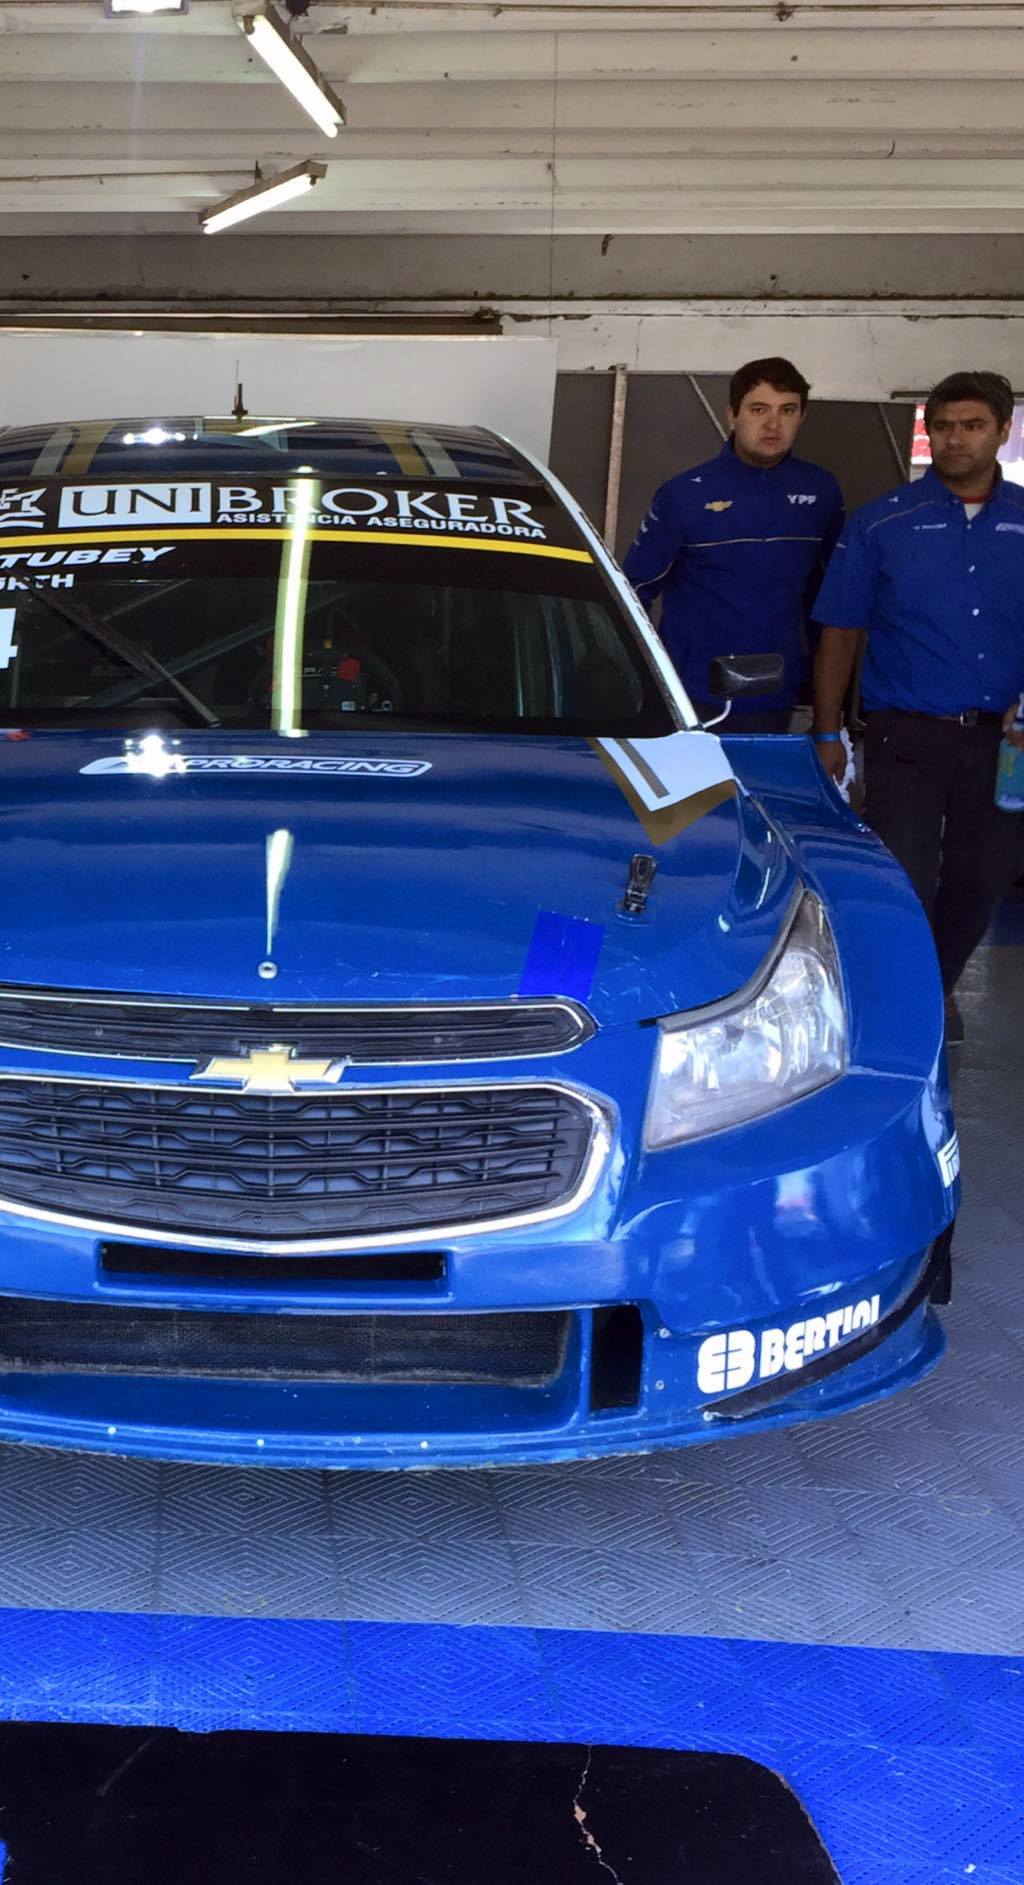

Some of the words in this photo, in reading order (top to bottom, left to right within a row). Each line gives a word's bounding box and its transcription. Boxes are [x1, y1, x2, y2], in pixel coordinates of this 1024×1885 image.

[787, 494, 817, 505] YPF
[367, 516, 547, 540] ASEGURADORA
[184, 758, 422, 774] PRORACING
[759, 1294, 880, 1378] BERTINI
